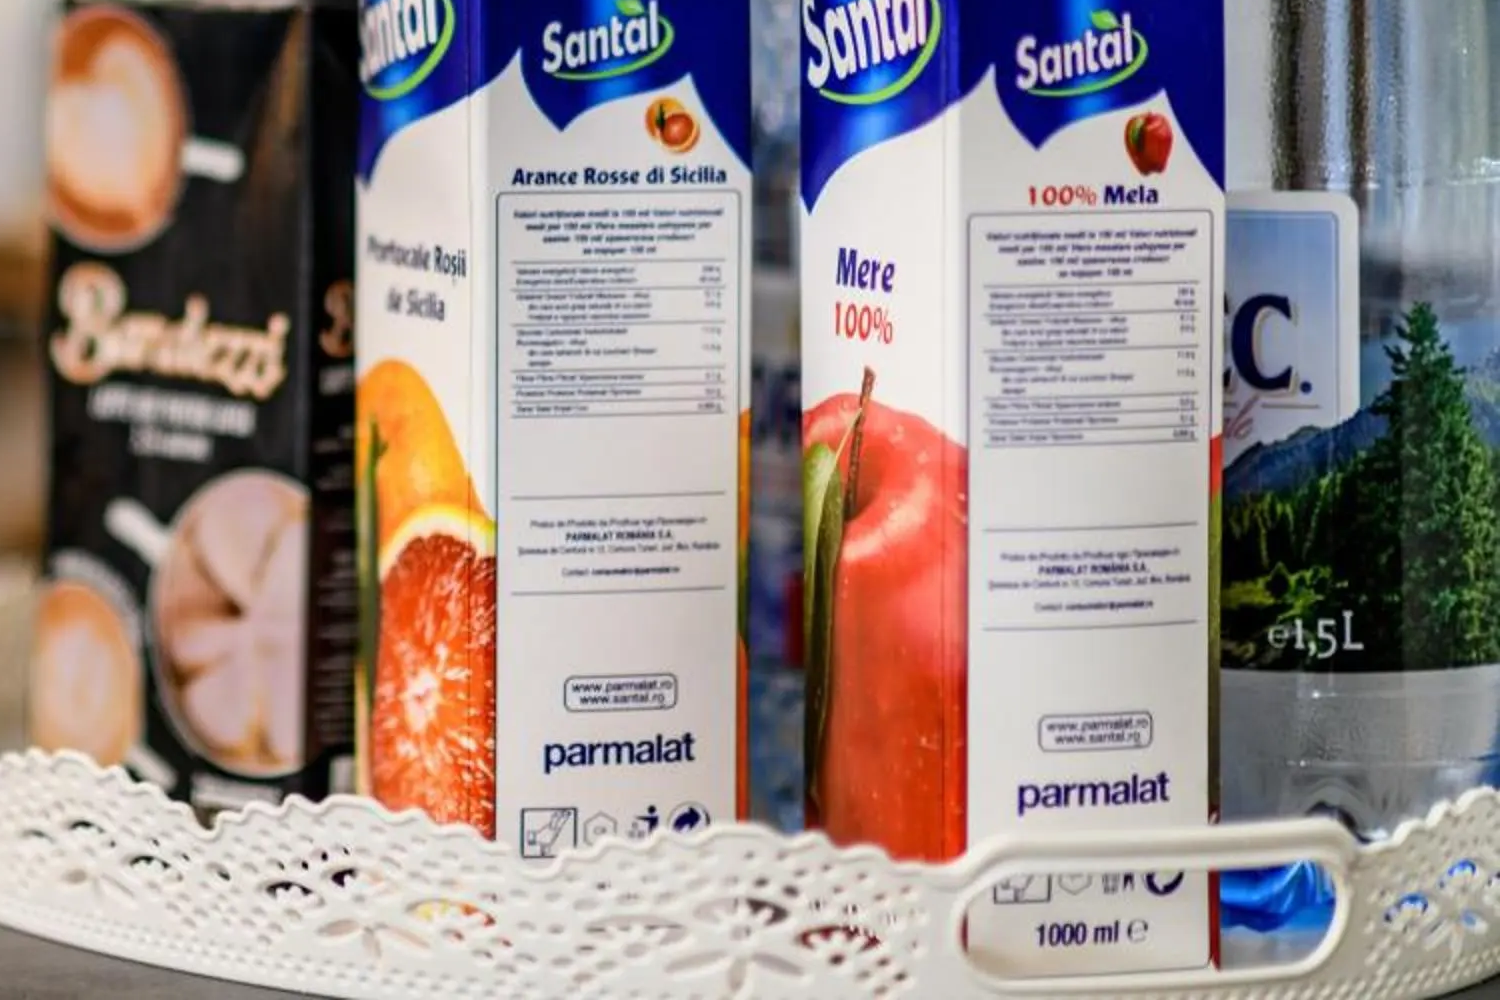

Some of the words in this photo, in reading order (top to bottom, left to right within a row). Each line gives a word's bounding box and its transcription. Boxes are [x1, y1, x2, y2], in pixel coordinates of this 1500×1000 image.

[542, 0, 659, 74] Santal
[1015, 13, 1135, 91] Santal
[511, 167, 578, 186] Arance
[583, 167, 640, 186] Rosse
[646, 166, 665, 185] di
[670, 166, 728, 185] Sicilia
[1028, 184, 1097, 207] 100%
[1103, 184, 1160, 205] Mela
[836, 246, 896, 294] Mere
[834, 302, 893, 346] 100%
[543, 732, 696, 775] parmalat
[1017, 771, 1171, 817] parmalat
[1036, 923, 1088, 948] 1000
[1092, 920, 1120, 944] ml
